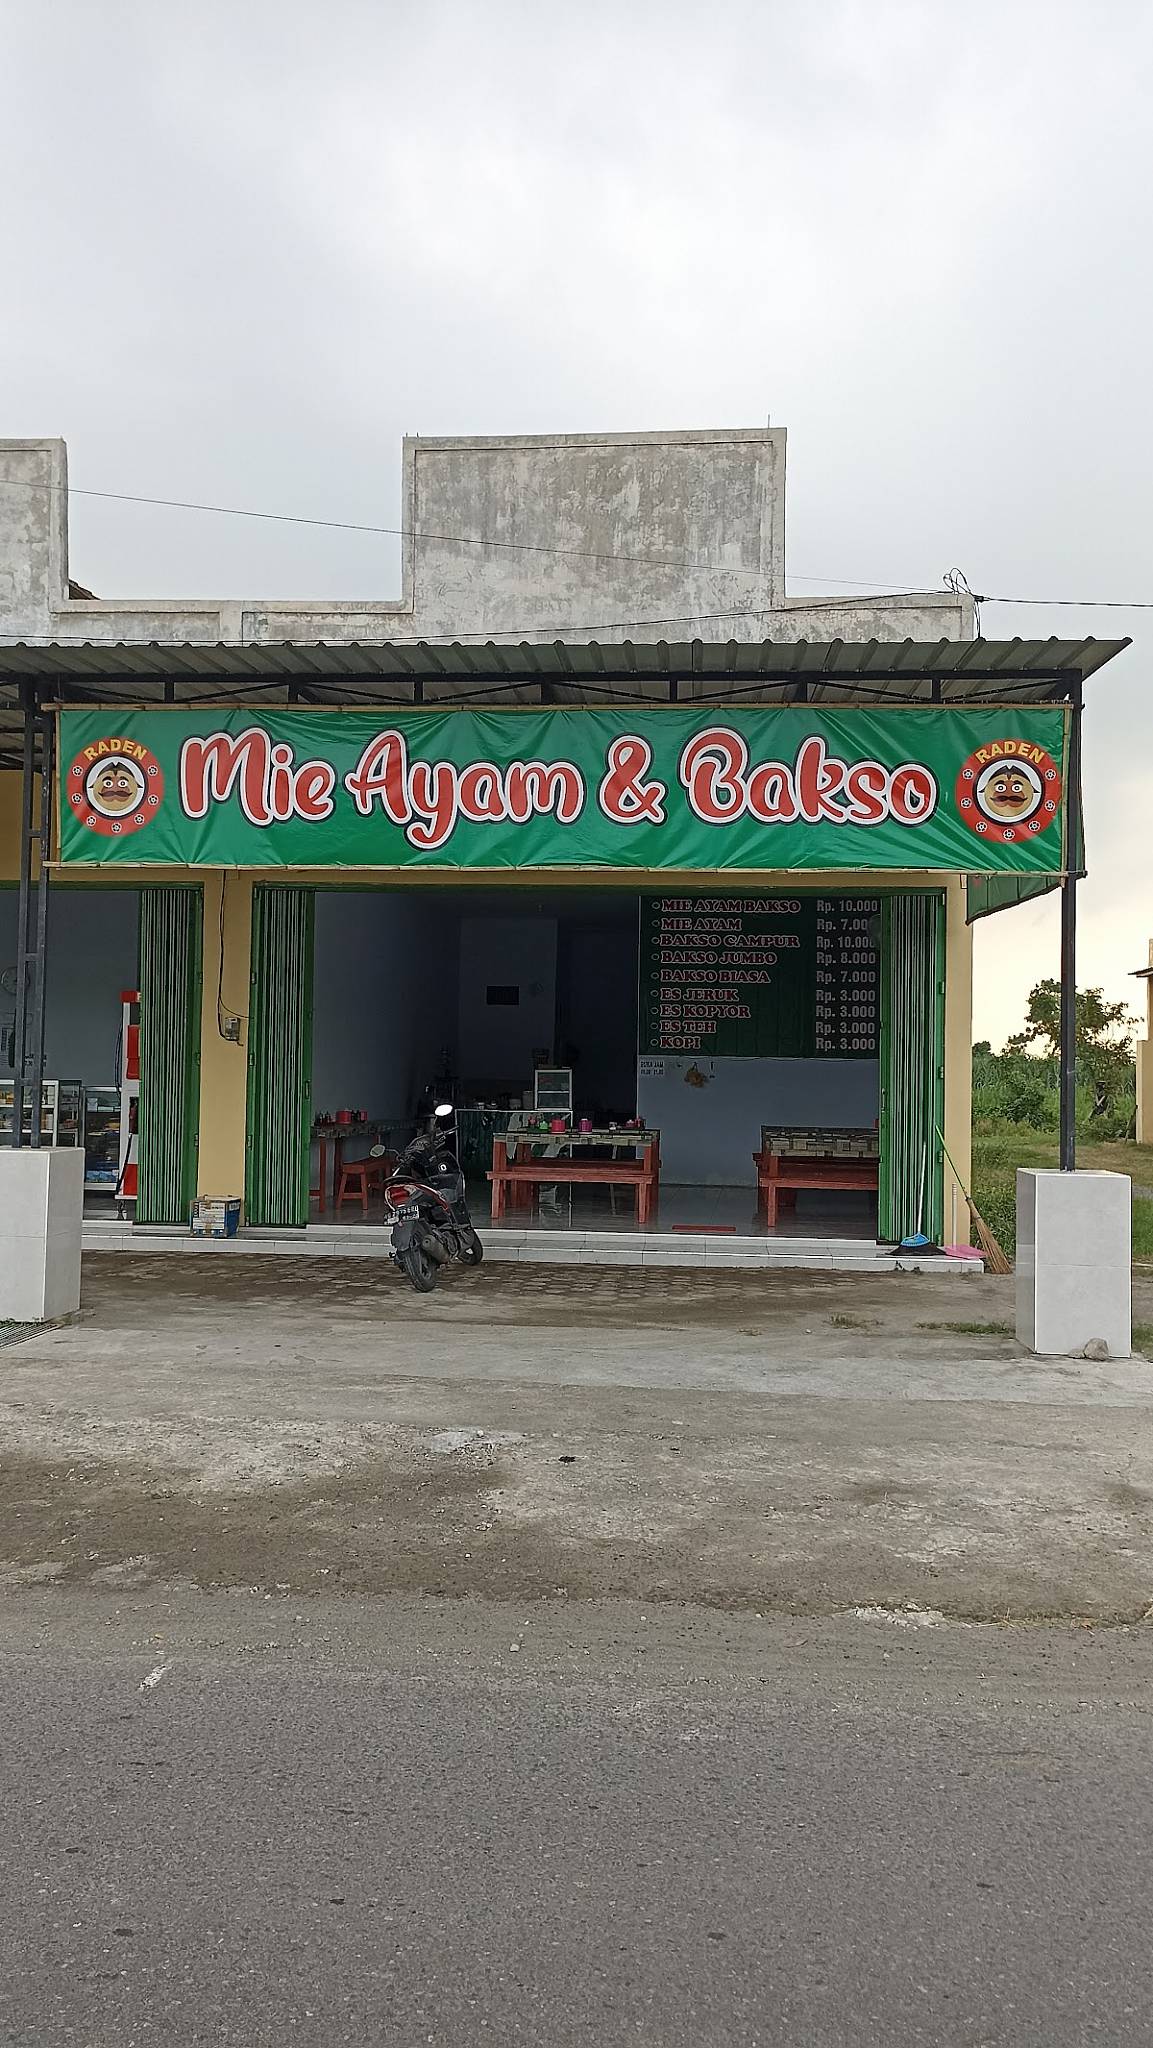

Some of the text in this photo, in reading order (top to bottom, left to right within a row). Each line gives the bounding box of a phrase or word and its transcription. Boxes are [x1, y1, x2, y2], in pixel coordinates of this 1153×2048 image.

[83, 738, 148, 761] RADEN
[975, 740, 1045, 764] RADEN
[179, 724, 938, 852] Mie Ayam & Bakso
[661, 899, 801, 914] MIE AYAM BAKSO
[816, 900, 878, 914] Rp. 10.000
[661, 918, 742, 931] MIE AYAM
[816, 918, 871, 933] Rp. 7.00
[660, 934, 800, 948] BAKSO CAMPUR
[816, 935, 834, 950] Rp.
[661, 951, 777, 965] BAKSO JUMBO
[816, 952, 876, 966] Rp. 8.000
[660, 969, 771, 983] BAKSO BIASA
[816, 970, 876, 985] Rp. 7.000
[660, 988, 739, 1001] ES JERUK
[815, 989, 876, 1004] Rp. 3.000
[660, 1004, 751, 1018] ES KOPYOR
[815, 1005, 875, 1020] Rp. 3.000
[660, 1020, 717, 1033] ES TEH
[815, 1021, 875, 1036] Rp. 3.000
[660, 1036, 701, 1049] KOPI
[815, 1037, 875, 1052] Rp. 3.000
